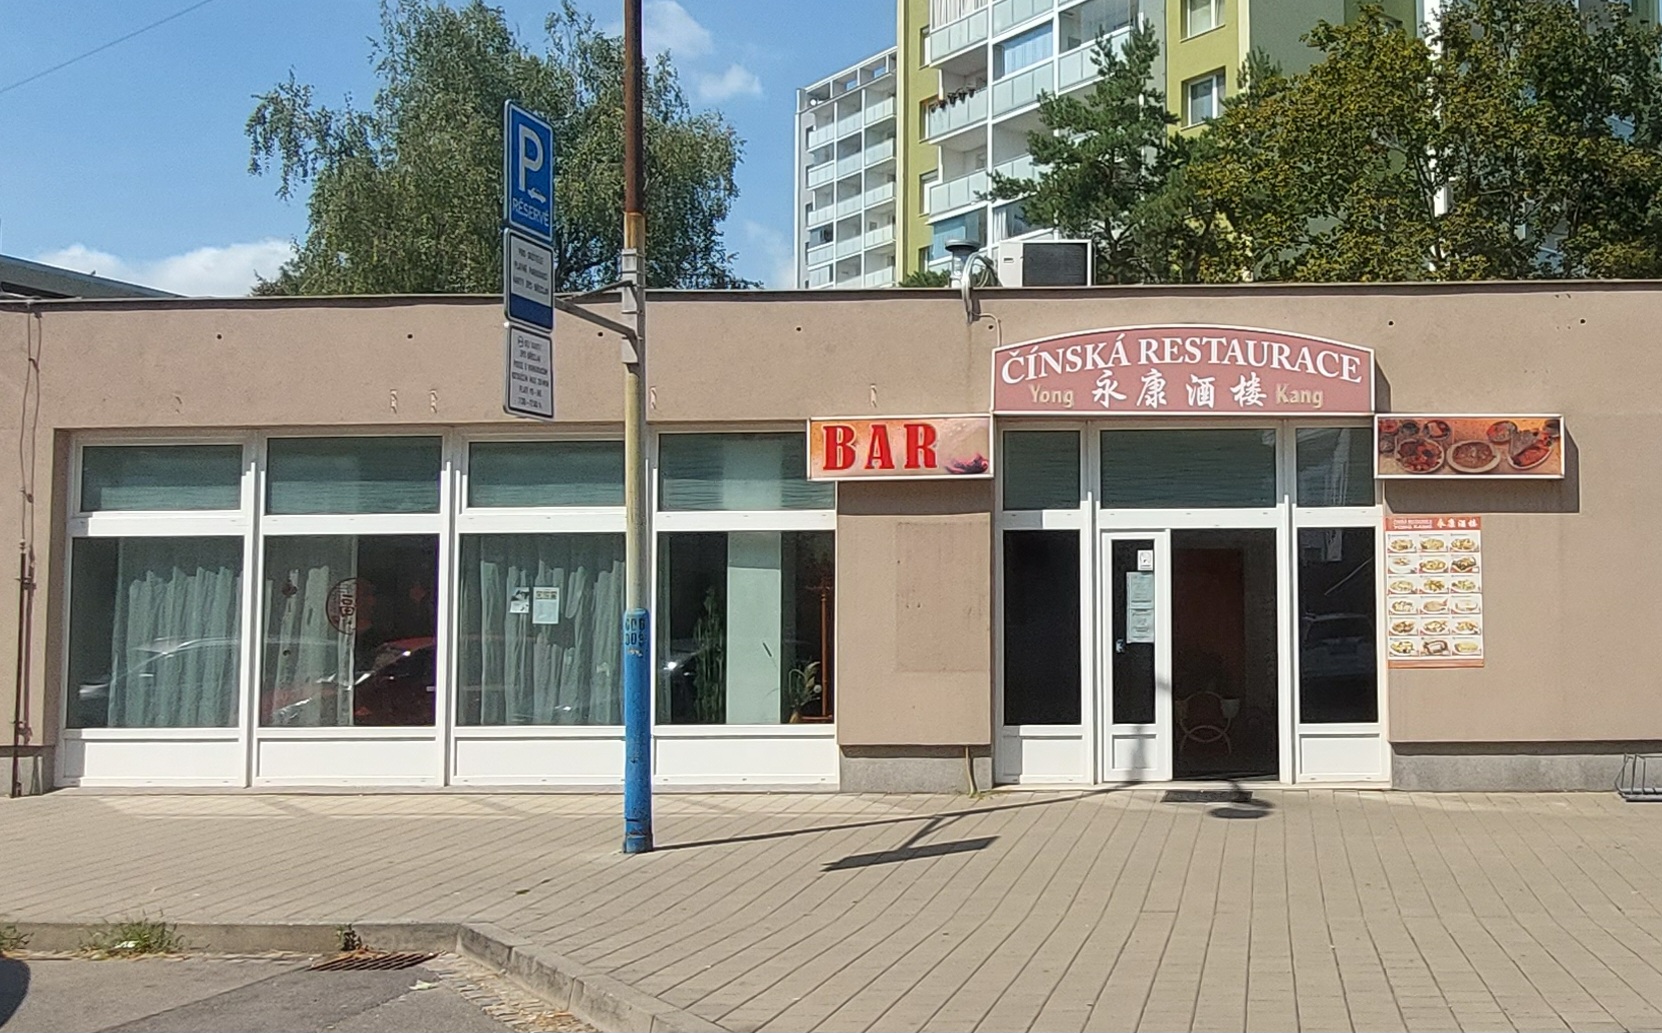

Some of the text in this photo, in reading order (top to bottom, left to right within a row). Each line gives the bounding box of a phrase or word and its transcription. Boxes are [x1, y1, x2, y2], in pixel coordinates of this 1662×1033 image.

[518, 123, 544, 192] P
[512, 197, 550, 227] RÉSERVÉ
[1001, 333, 1362, 384] ČÍNSKÁ RESTAURACE
[1028, 383, 1075, 409] Yong
[1275, 382, 1324, 409] Kang
[822, 423, 939, 471] BAR
